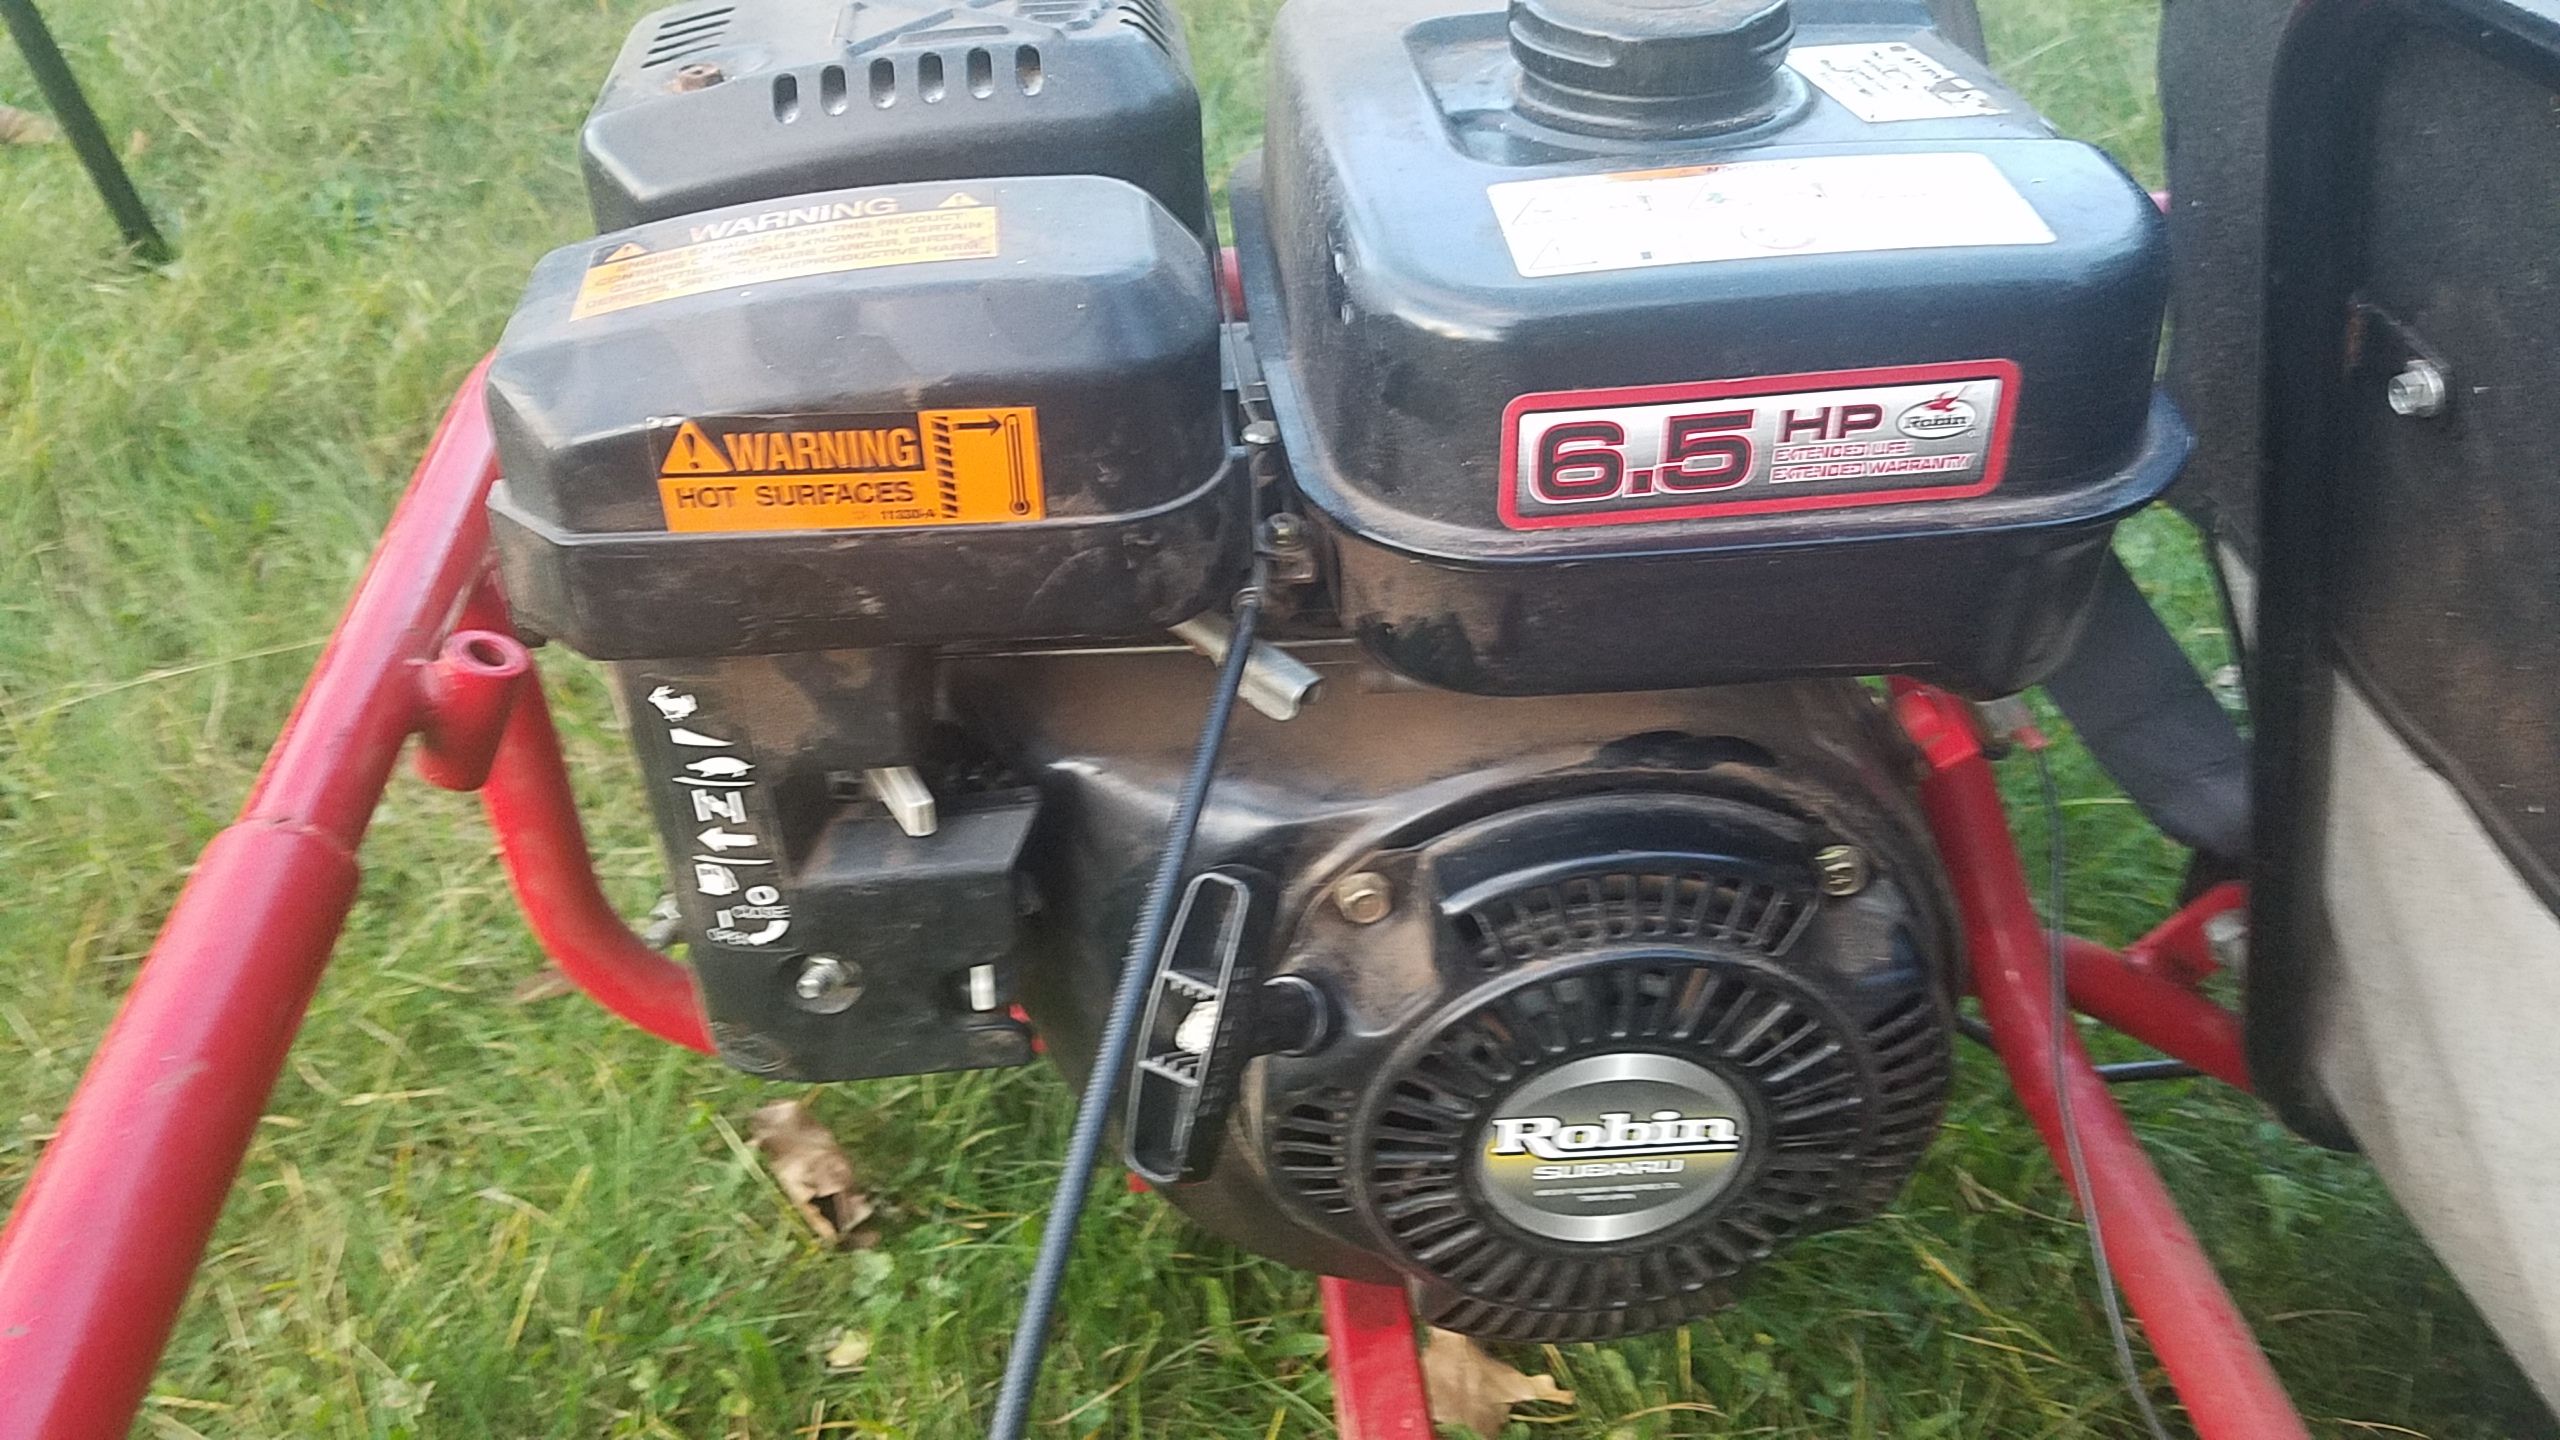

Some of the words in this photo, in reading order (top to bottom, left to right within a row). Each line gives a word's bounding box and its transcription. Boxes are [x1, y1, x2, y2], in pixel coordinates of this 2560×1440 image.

[689, 198, 898, 242] WARNING
[833, 221, 874, 231] THIS
[876, 212, 966, 227] PRODUCT
[690, 240, 797, 266] CEMICALS
[904, 221, 984, 235] CERTAIN
[1775, 402, 1885, 446] HP
[1902, 413, 1969, 430] Robin
[722, 428, 921, 472] WARNING
[1530, 408, 1757, 504] 6.5
[1770, 463, 1867, 483] EXTENDED
[1869, 453, 1973, 475] WARRANTY
[1773, 442, 1868, 464] EXTENDED
[1871, 439, 1914, 457] LIFE
[677, 486, 738, 510] HOT
[754, 480, 915, 507] SURFACES
[1490, 1110, 1740, 1160] Robin
[1531, 1159, 1685, 1180] SUBARU
